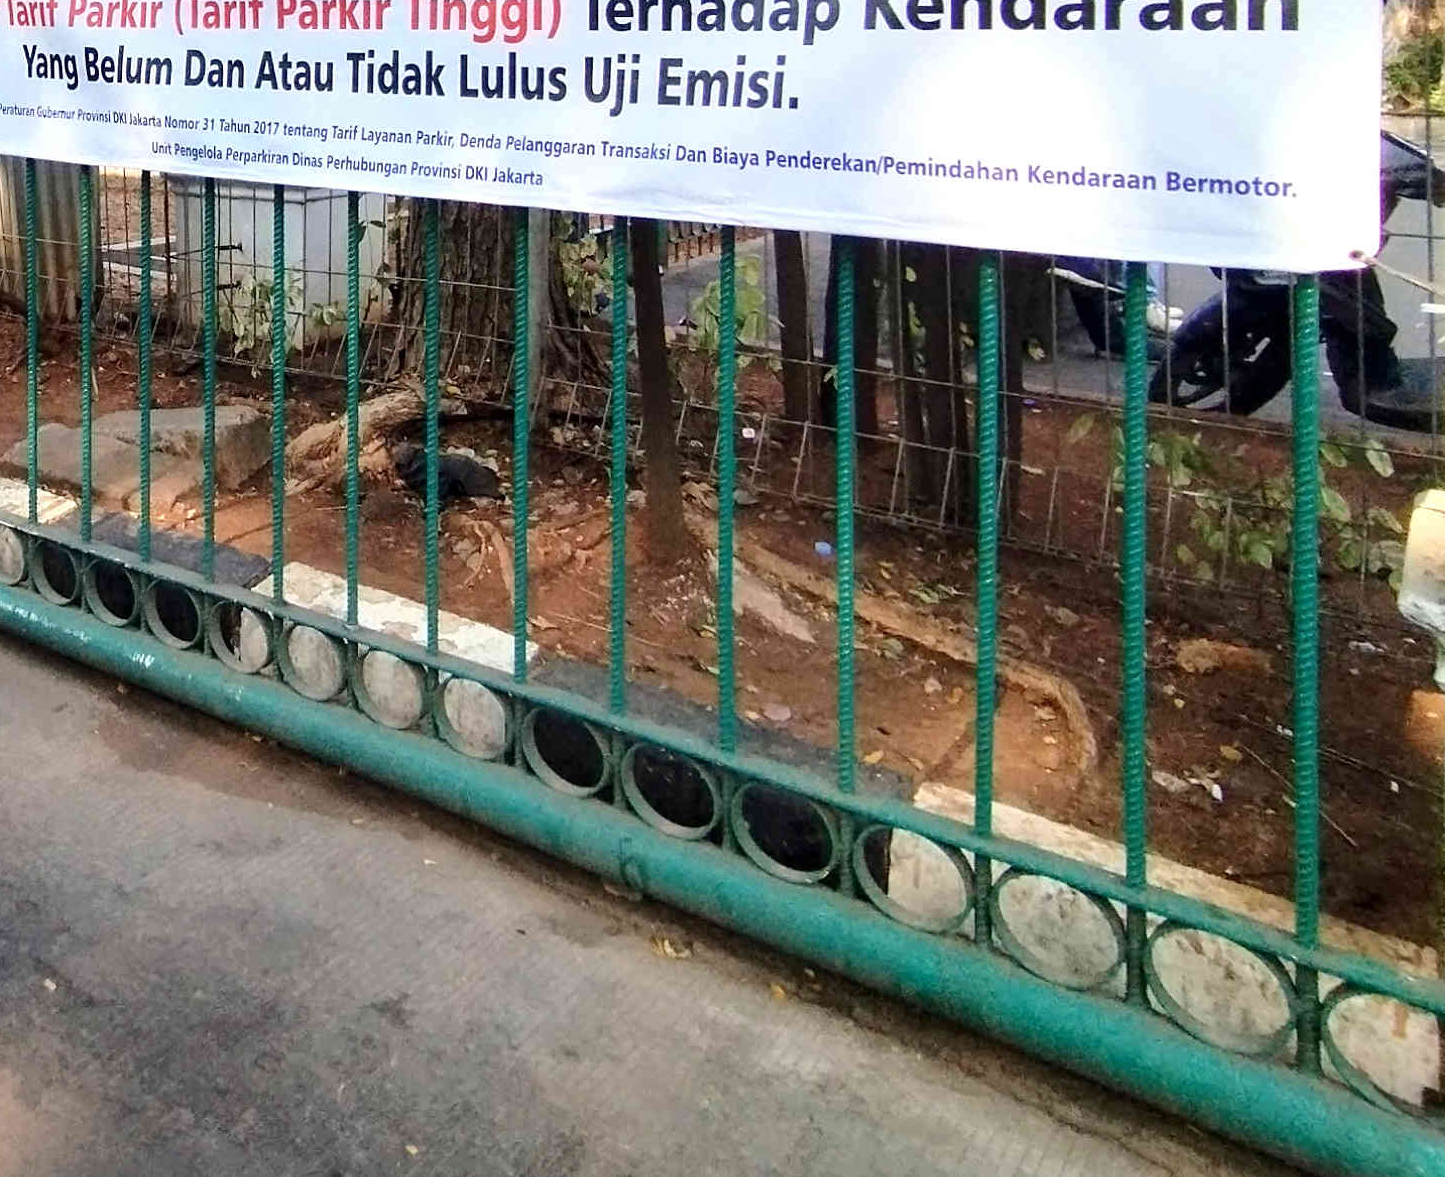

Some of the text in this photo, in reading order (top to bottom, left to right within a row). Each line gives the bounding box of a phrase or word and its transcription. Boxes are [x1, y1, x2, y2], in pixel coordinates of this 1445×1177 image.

[23, 45, 798, 117] Yang Belum Dan Atau Tidak Lulus Uji Emisi.
[37, 106, 75, 119] Gubernur
[78, 109, 110, 123] Provinsi
[113, 112, 127, 124] DKI
[130, 113, 161, 127] Jakarta
[165, 116, 199, 129] Nomor
[203, 118, 214, 131] 31
[220, 118, 250, 133] Tahun
[254, 121, 279, 134] 2017
[284, 124, 328, 142] tentang
[332, 126, 358, 140] Tarif
[362, 127, 411, 145] Layanan
[416, 130, 454, 148] Parkir,
[460, 133, 501, 149] Denda
[506, 136, 595, 157] Pelanggaran
[601, 141, 671, 160] Transaksi
[676, 145, 706, 162] Dan
[713, 147, 759, 170] Biaya
[766, 150, 1018, 181] Penderekan/Pemindahan
[1029, 166, 1156, 190] Kendaraan
[1167, 172, 1296, 197] Bermotor.
[152, 142, 543, 185] Unit Pengelola Perparkiran Dinas Perhubungan Provinsi DKI Jakarta
